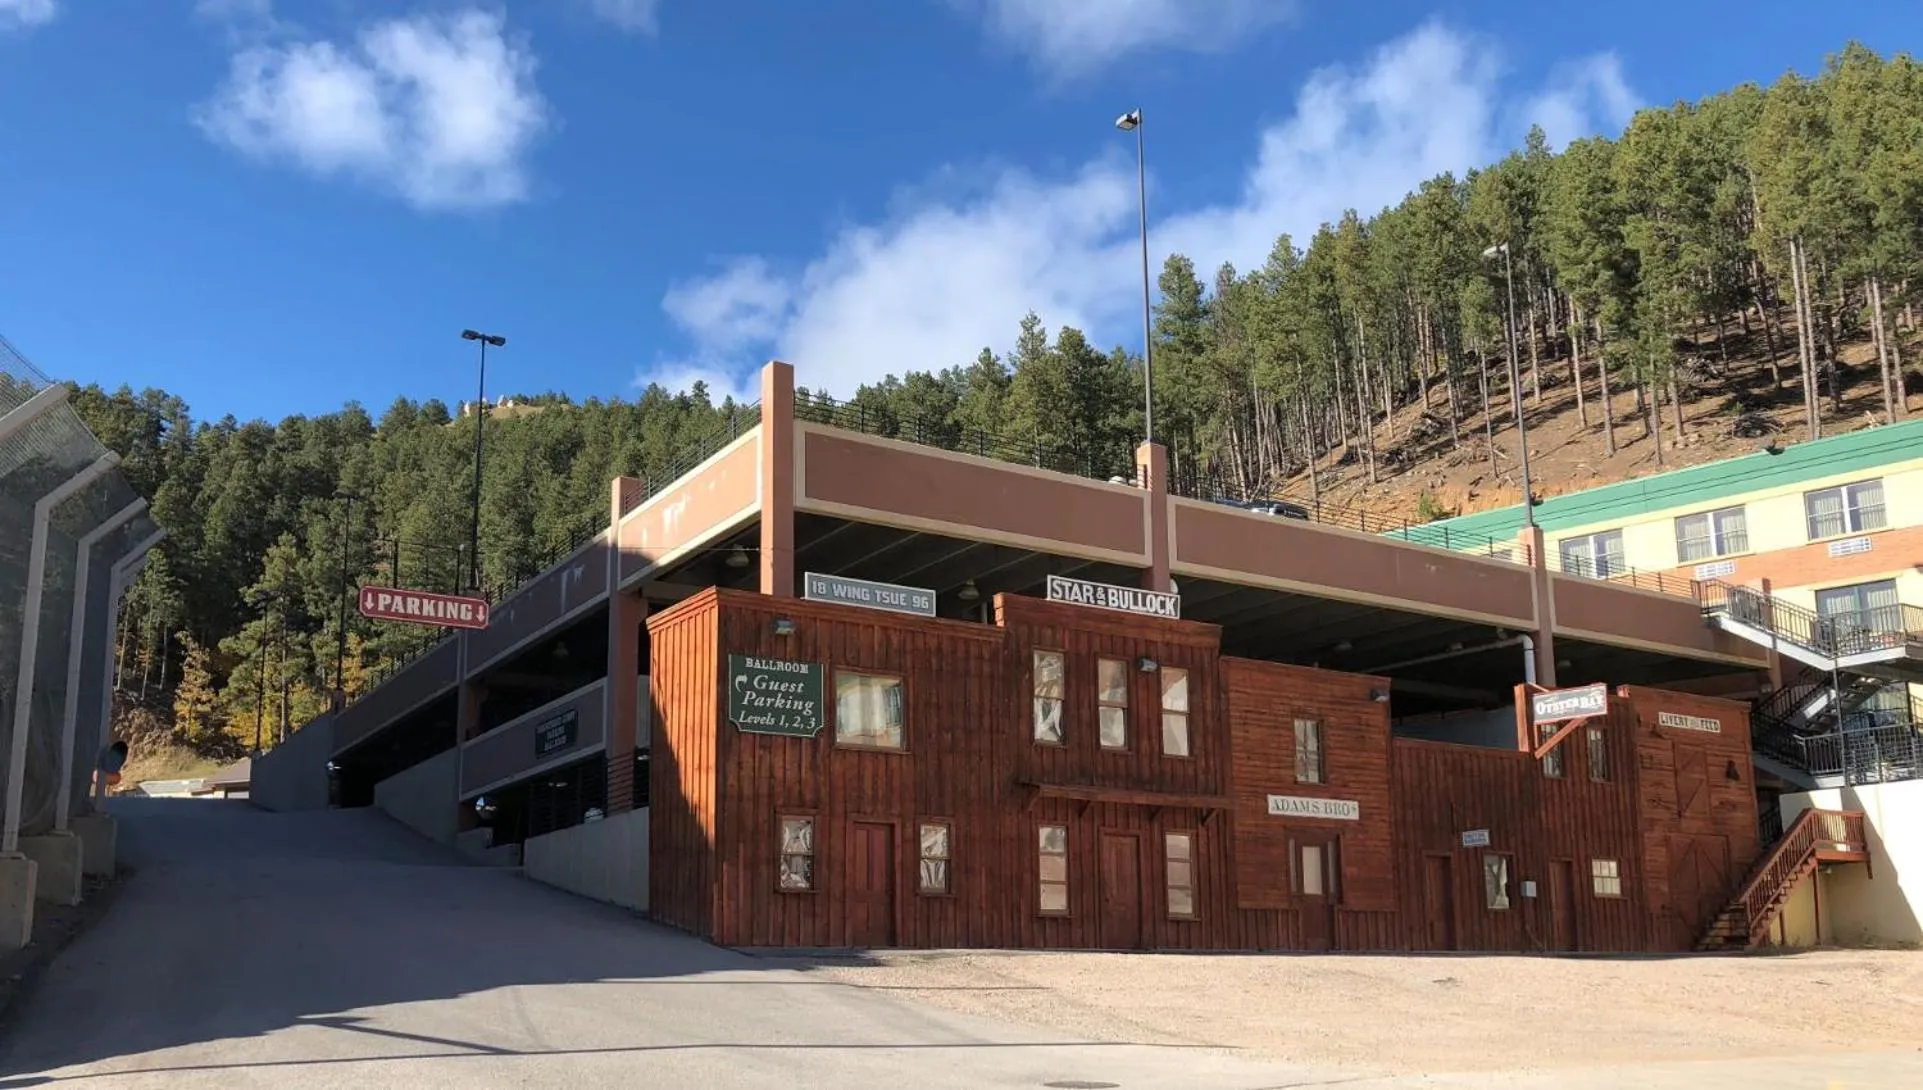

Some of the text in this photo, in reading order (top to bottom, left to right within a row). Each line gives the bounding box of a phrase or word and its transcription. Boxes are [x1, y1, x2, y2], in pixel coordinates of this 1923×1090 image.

[377, 593, 473, 620] PARKING
[832, 583, 870, 601] WING
[874, 589, 908, 606] TSUE
[912, 595, 929, 609] 96
[1052, 580, 1095, 605] STAR
[1107, 588, 1177, 616] BULLOCK
[745, 657, 809, 674] BALLROOM
[753, 674, 805, 693] Guest
[741, 690, 815, 716] Parking
[738, 710, 776, 726] Levels
[1272, 799, 1321, 814] ADAMS
